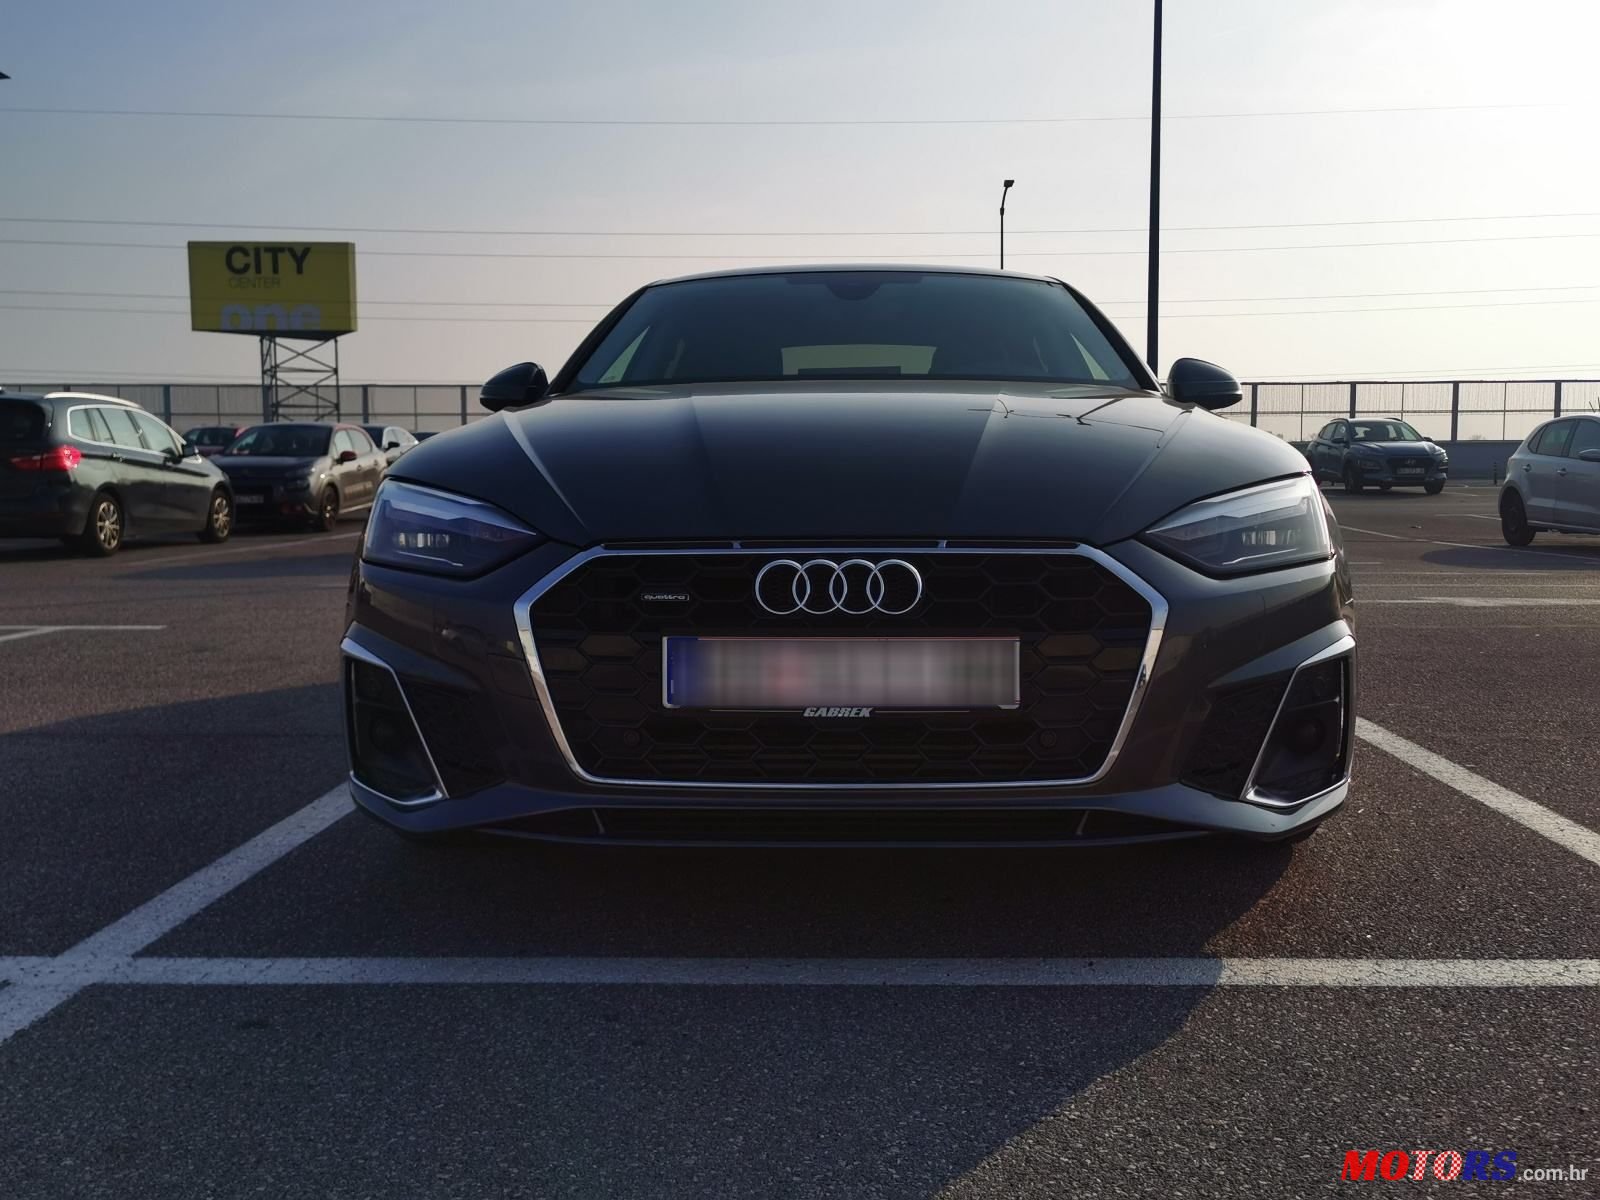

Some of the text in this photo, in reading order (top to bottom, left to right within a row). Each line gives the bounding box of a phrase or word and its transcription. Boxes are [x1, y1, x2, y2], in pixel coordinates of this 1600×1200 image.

[225, 246, 312, 275] CITY
[229, 277, 281, 289] CENTER
[221, 303, 321, 331] one
[803, 707, 874, 718] GABREK
